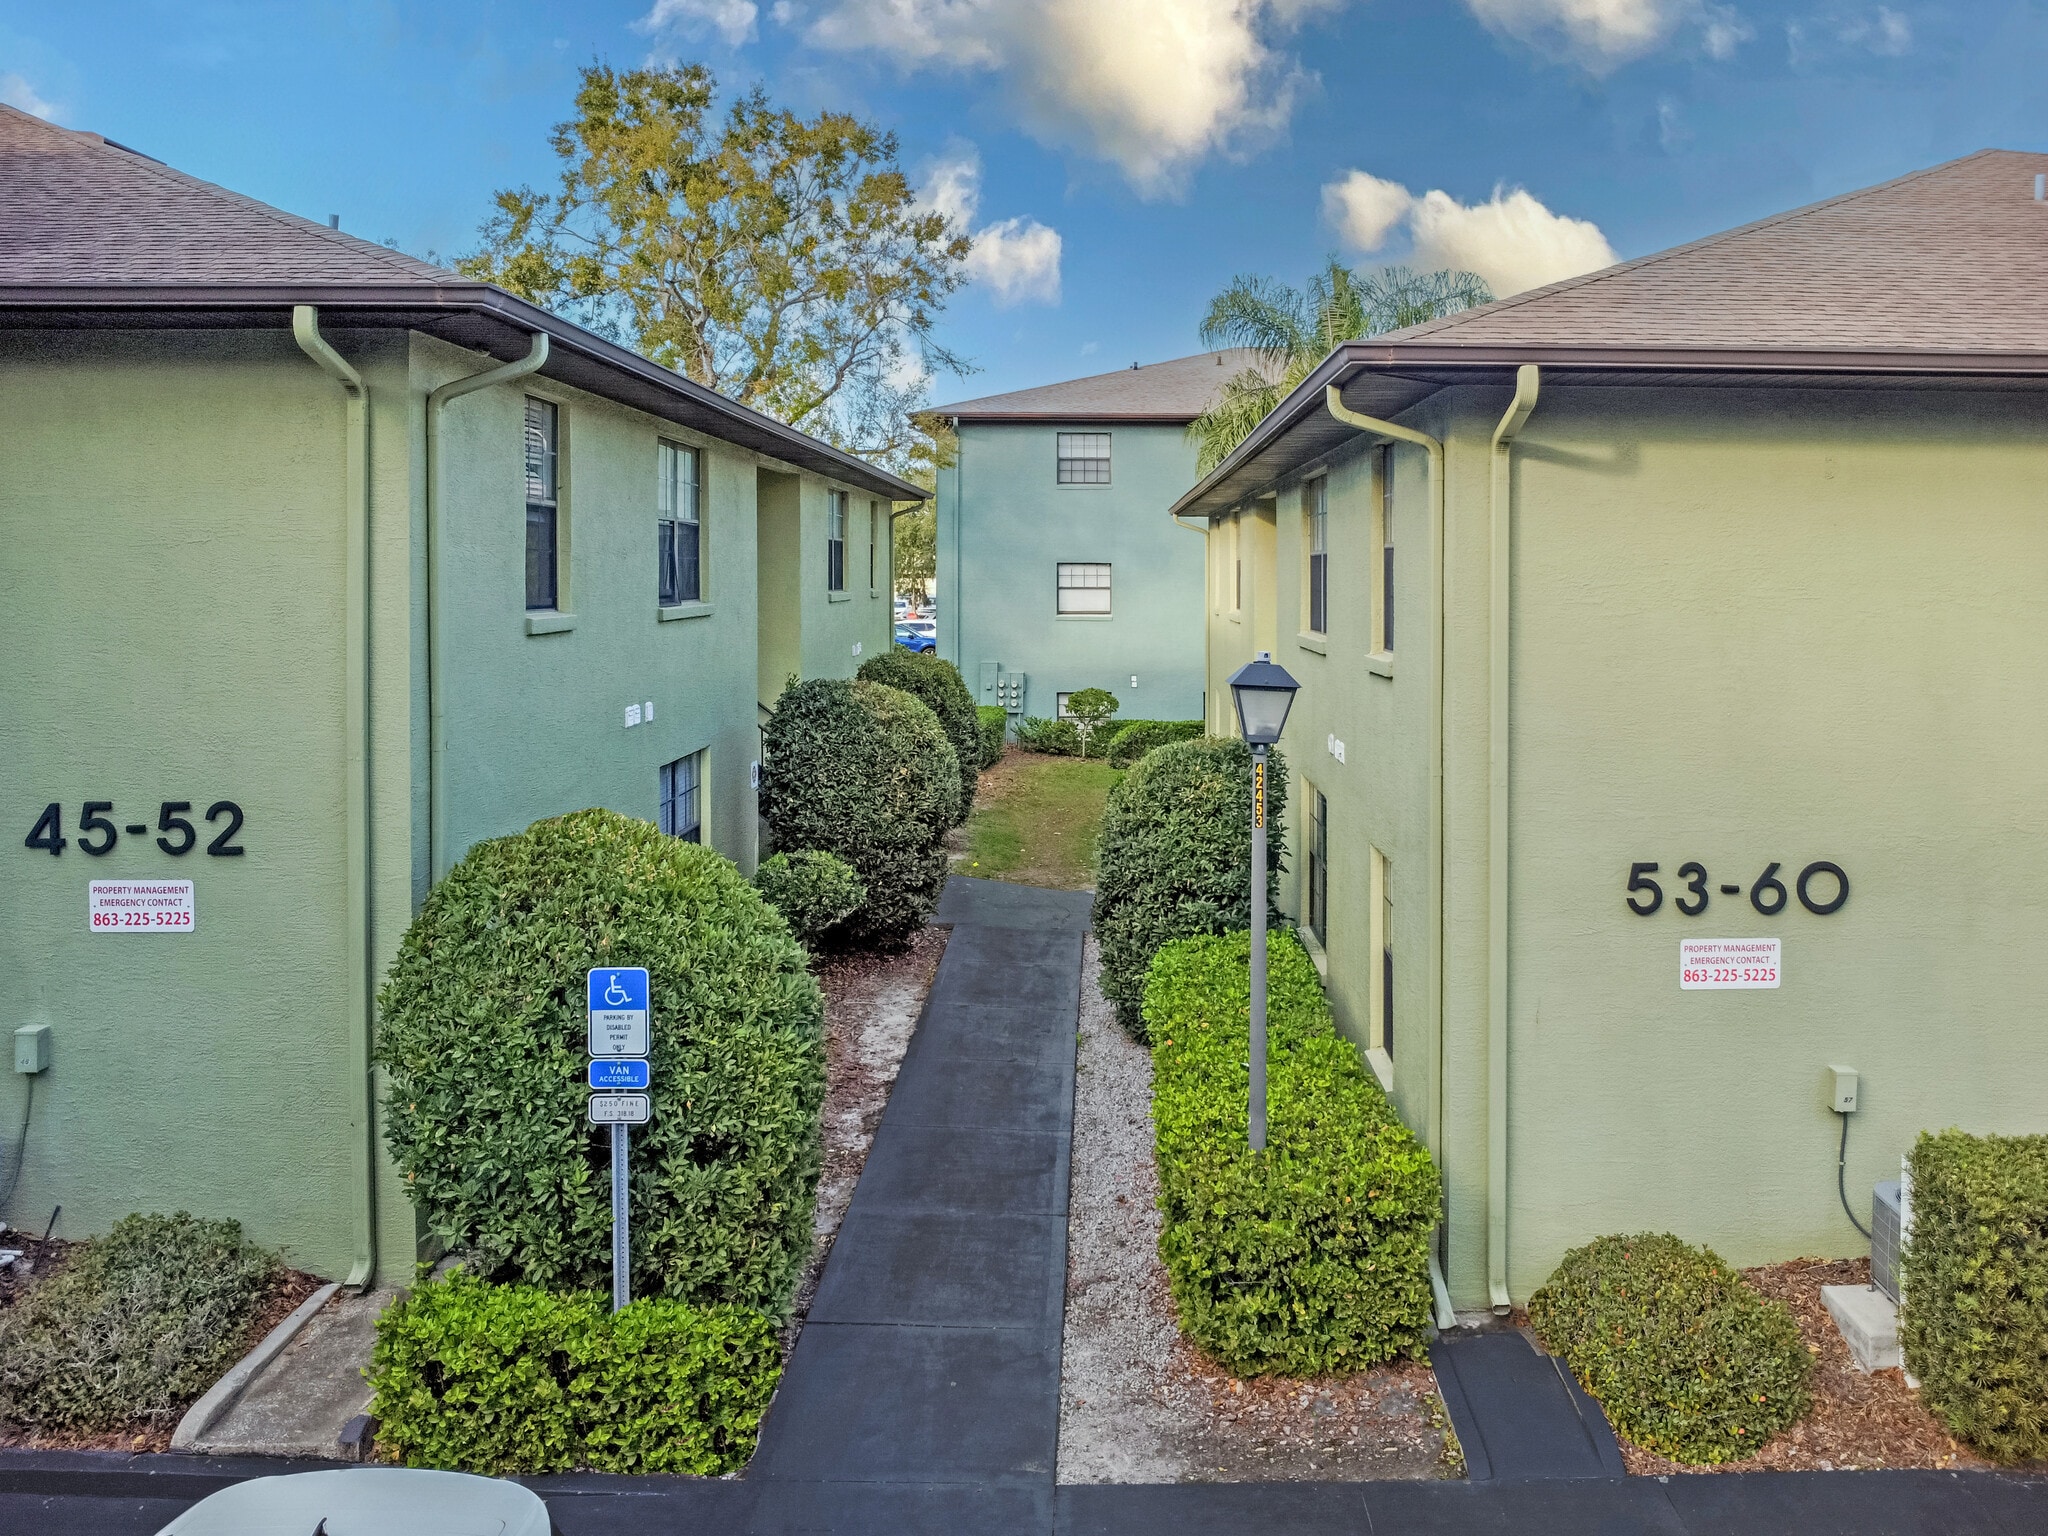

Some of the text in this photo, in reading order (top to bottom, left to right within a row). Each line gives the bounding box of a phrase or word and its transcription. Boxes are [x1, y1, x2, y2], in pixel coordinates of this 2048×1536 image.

[1255, 763, 1263, 828] 42453
[25, 801, 244, 856] 45-52
[93, 886, 189, 895] PROPERTY MANAGEMENT
[1626, 861, 1850, 916] 53-60
[99, 898, 183, 907] EMERGENCY CONTACT
[93, 912, 191, 926] 863-225-5225
[1684, 943, 1776, 953] PROPERTY MANAGEMENT
[1690, 955, 1770, 965] EMERGENCY CONTACT
[1683, 968, 1776, 982] 863-225-5225
[609, 1066, 630, 1075] VAN
[599, 1075, 639, 1083] ACCESSIBLE
[599, 1100, 619, 1108] $250
